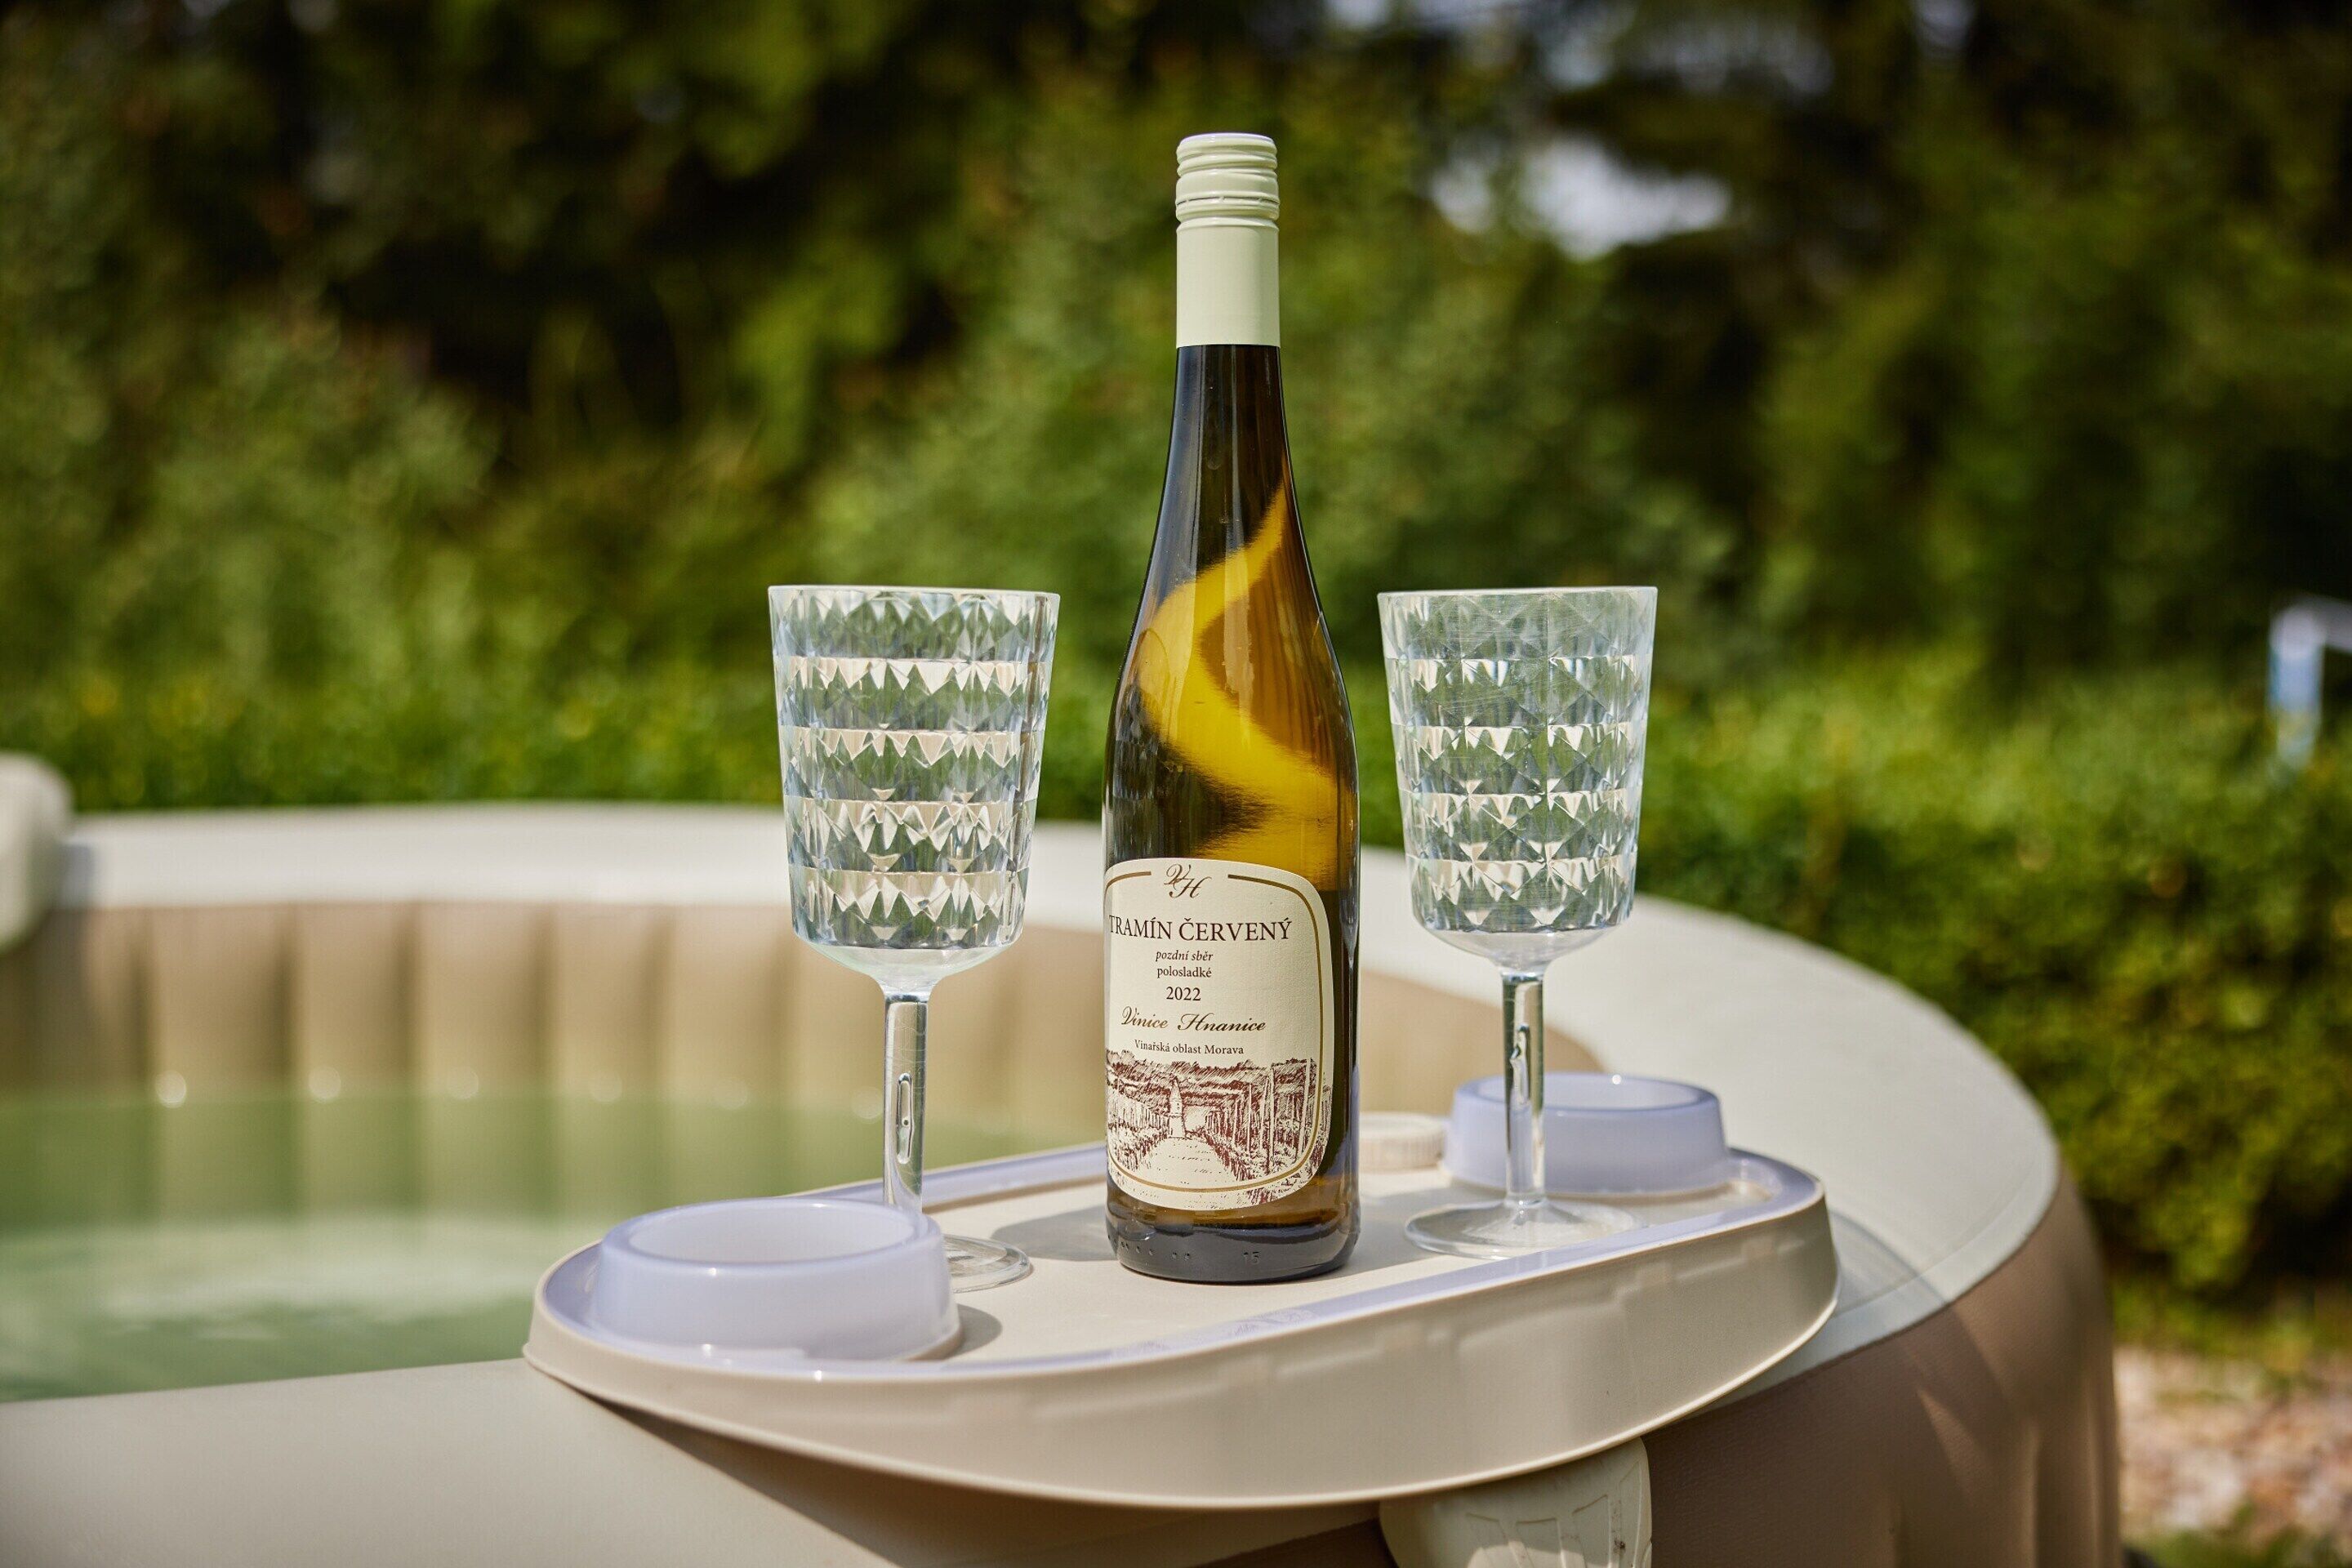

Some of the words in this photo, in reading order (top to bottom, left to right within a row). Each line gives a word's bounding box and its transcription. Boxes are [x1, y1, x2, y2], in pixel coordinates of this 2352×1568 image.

[1109, 915, 1172, 940] TRAMÍN
[1178, 917, 1293, 942] ČERVENÝ
[1156, 949, 1189, 962] pozdní
[1192, 951, 1214, 961] sběr
[1156, 966, 1212, 978] polosladké
[1166, 987, 1201, 1001] 2022
[1120, 1005, 1169, 1029] Vinice
[1177, 1012, 1267, 1032] Hnanice
[1134, 1039, 1170, 1054] Vinařská
[1172, 1043, 1201, 1054] oblast
[1205, 1045, 1244, 1054] Morava
